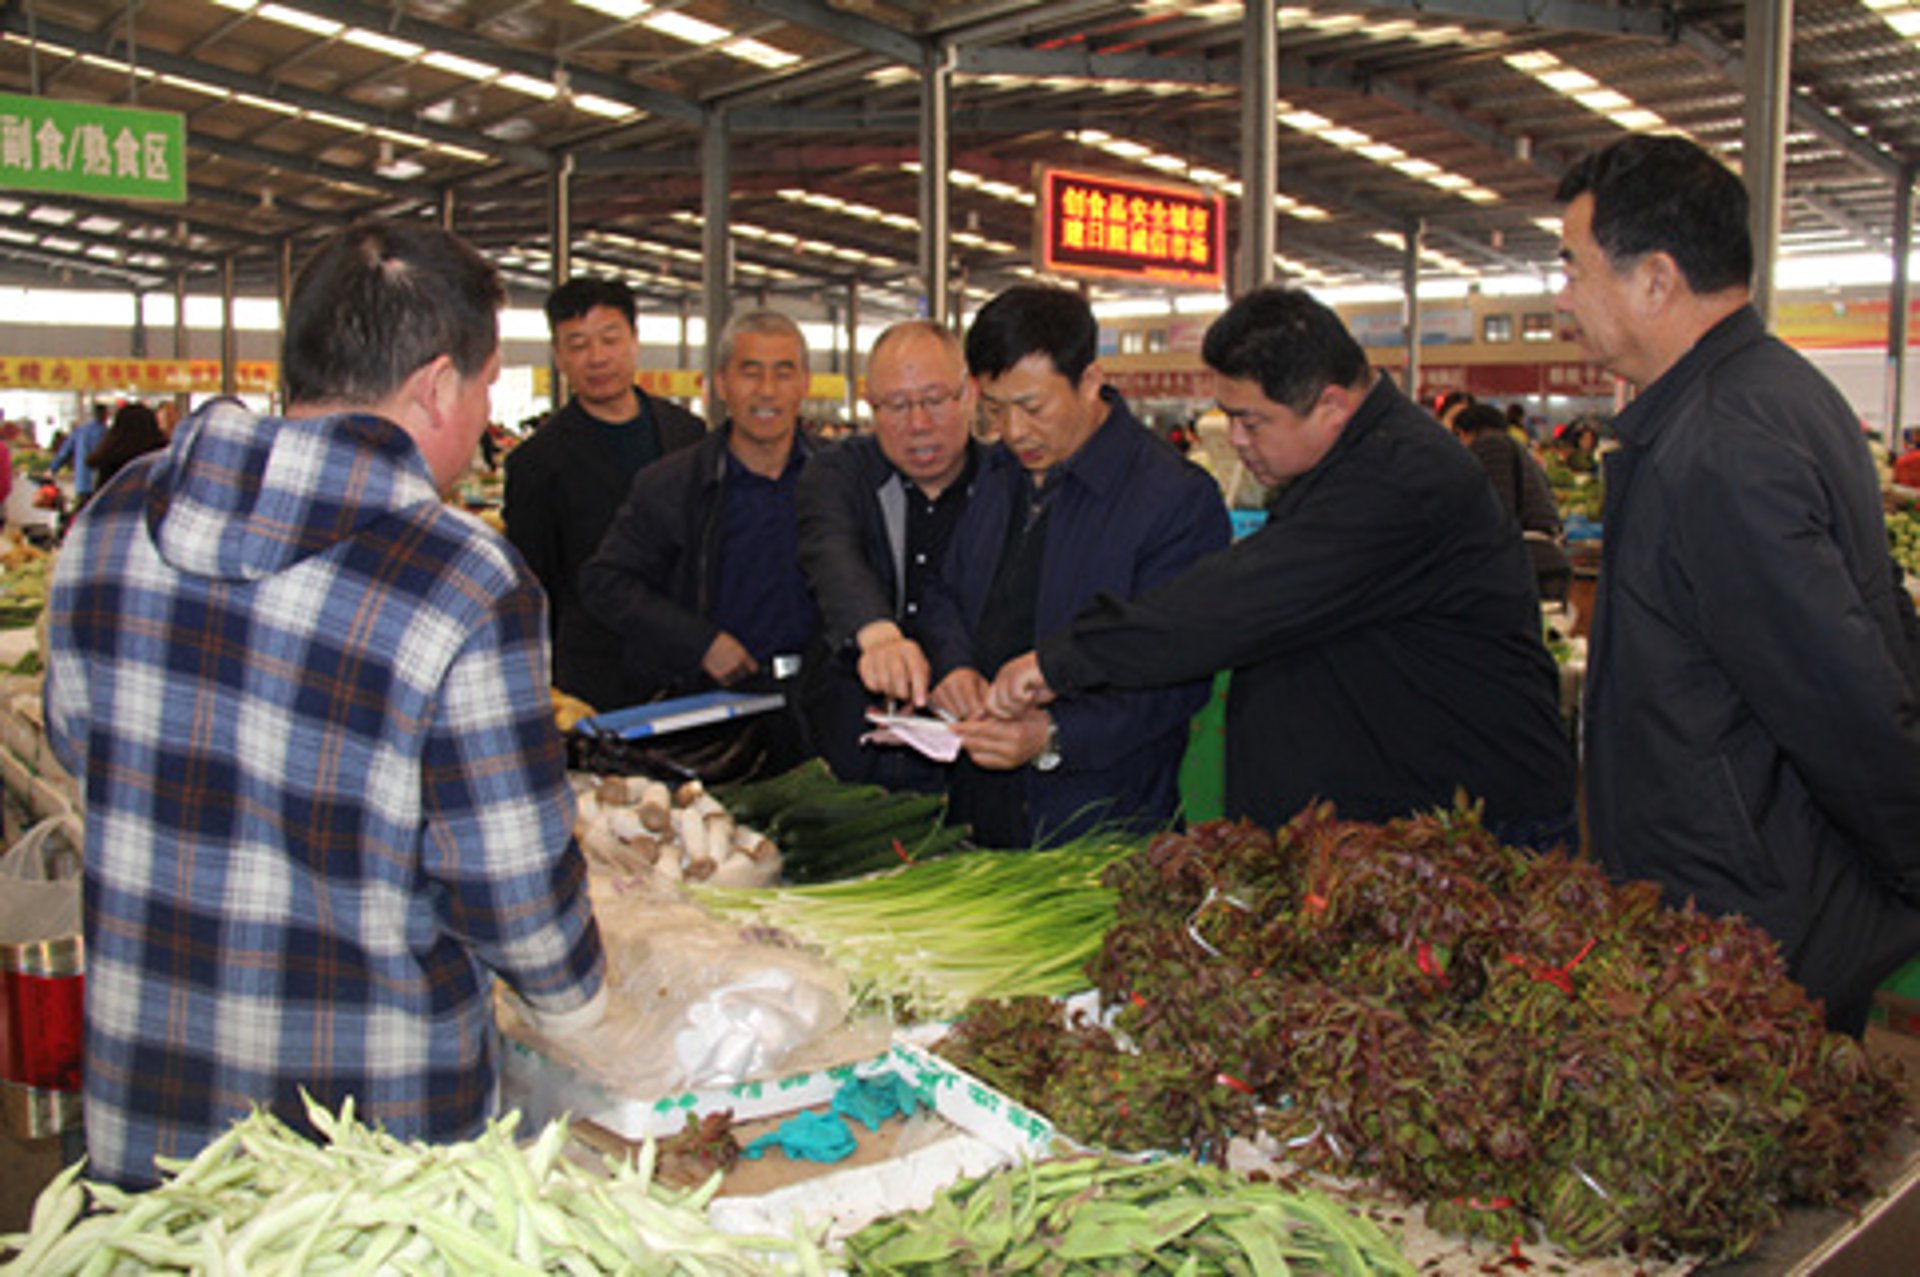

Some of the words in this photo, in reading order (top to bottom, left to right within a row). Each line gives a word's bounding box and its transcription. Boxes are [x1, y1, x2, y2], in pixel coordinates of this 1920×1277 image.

[0, 115, 169, 181] 副食/熟食区
